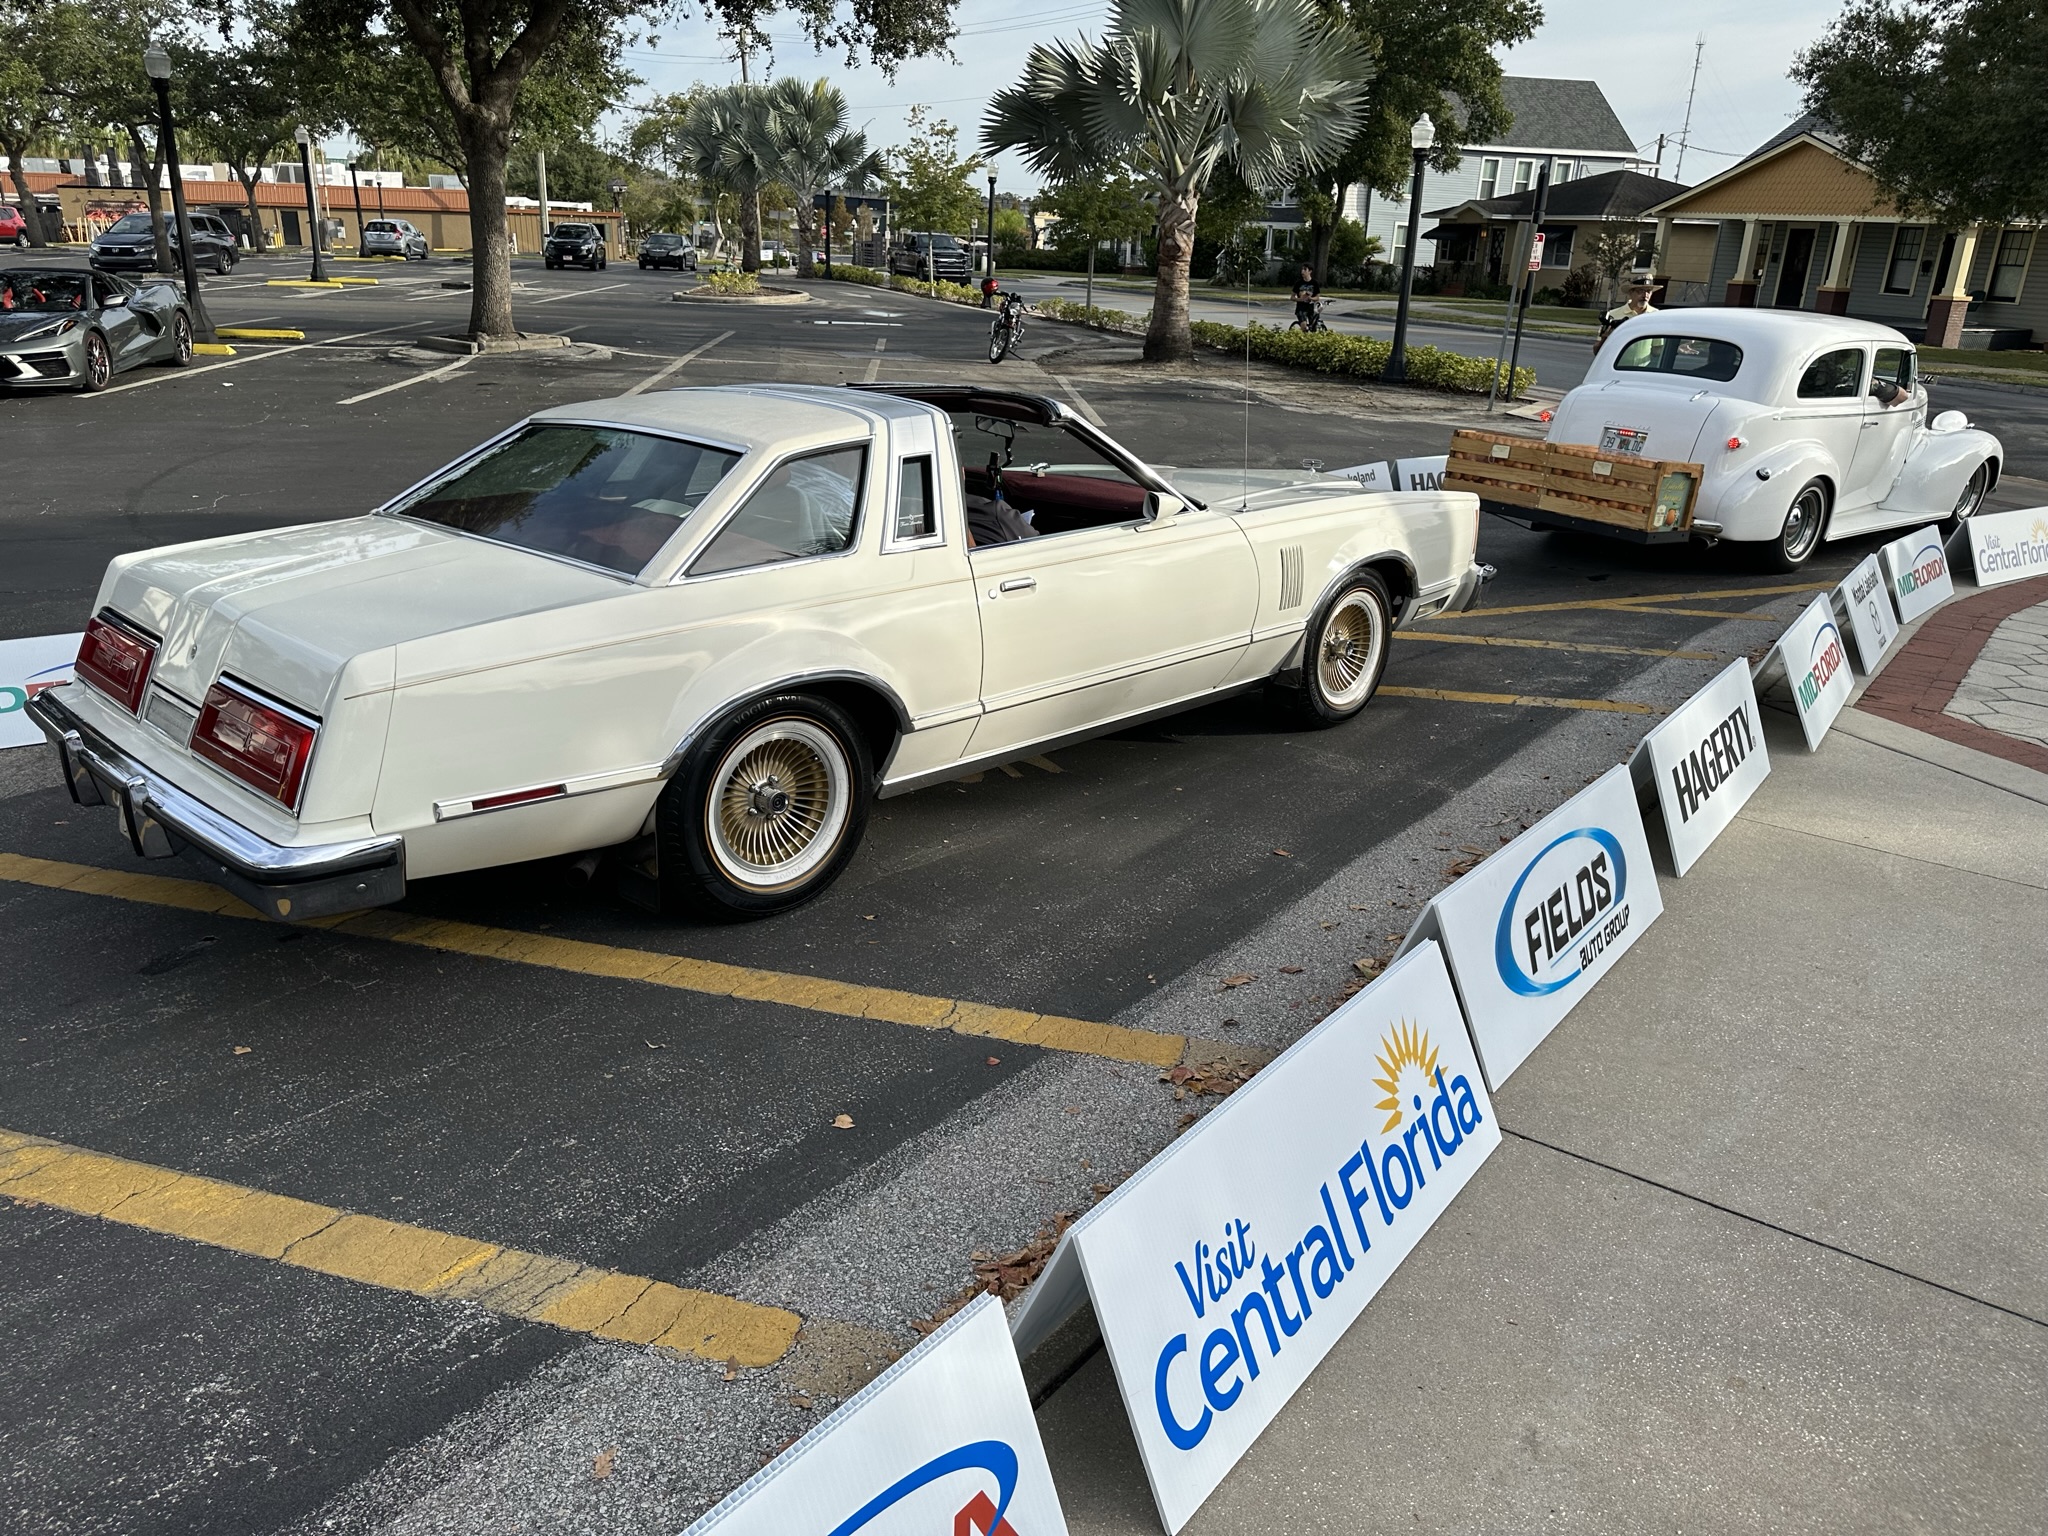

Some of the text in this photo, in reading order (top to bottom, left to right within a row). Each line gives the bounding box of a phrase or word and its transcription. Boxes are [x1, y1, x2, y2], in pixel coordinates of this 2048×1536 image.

[1979, 539, 2048, 573] Central Flori
[1984, 534, 2001, 550] Visit
[1897, 557, 1947, 598] MIDFLORIDA
[1798, 637, 1844, 713] MIDFLORIDA
[1524, 851, 1612, 976] FIELDS
[1604, 904, 1630, 947] GROUP
[1154, 1064, 1483, 1451] Central Florida
[1174, 1218, 1255, 1319] Visit
